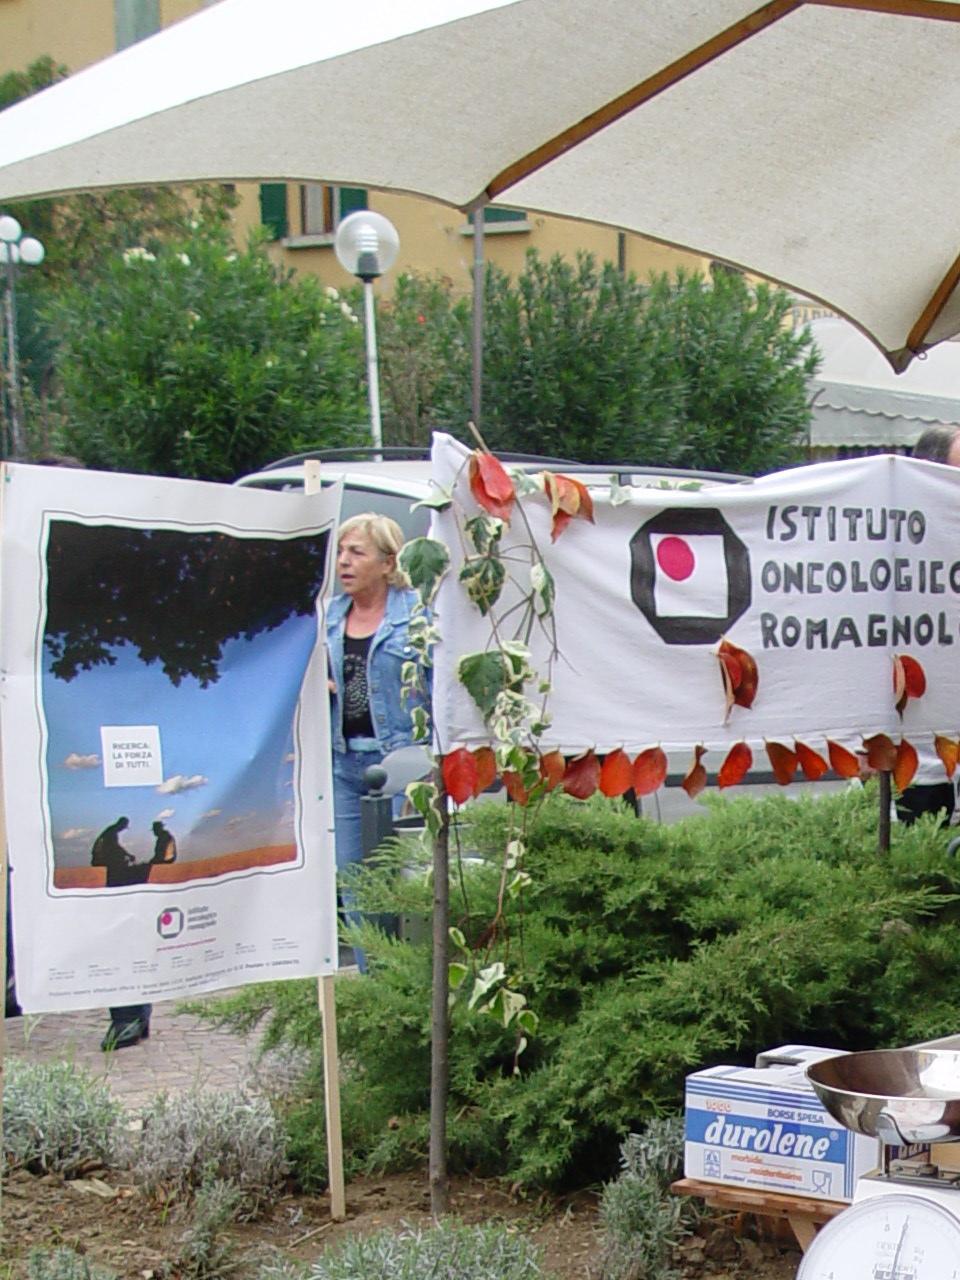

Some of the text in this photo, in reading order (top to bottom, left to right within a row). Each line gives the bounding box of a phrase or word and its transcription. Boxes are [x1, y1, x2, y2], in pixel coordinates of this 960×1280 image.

[766, 505, 926, 545] ISTITUTO
[125, 751, 152, 759] FORZA
[767, 1108, 825, 1125] BORSE SPESA
[704, 1115, 830, 1160] durolene
